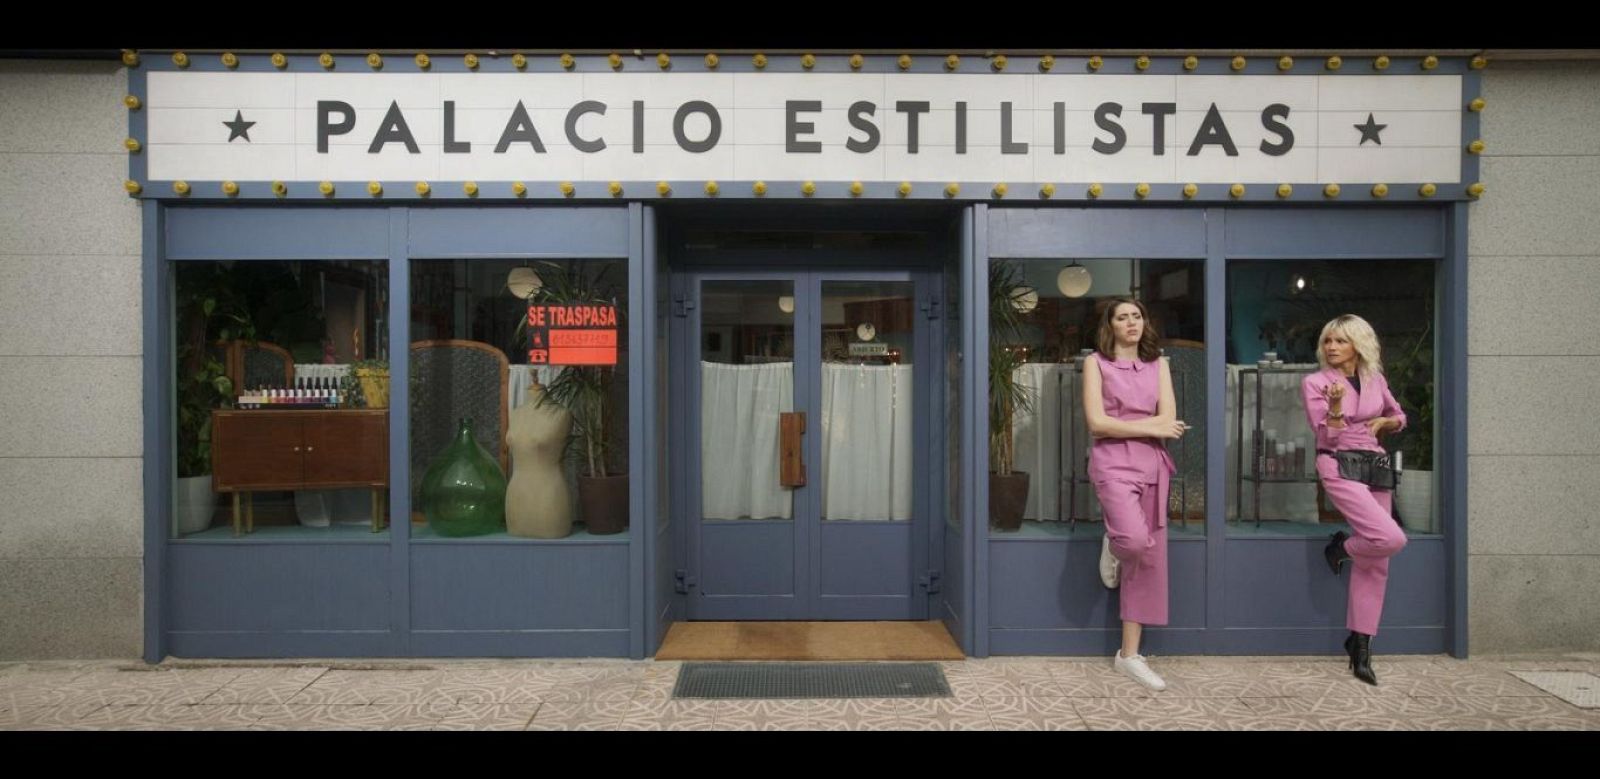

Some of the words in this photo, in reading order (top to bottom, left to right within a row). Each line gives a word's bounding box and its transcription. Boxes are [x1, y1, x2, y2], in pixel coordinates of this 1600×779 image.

[317, 99, 724, 155] PALACIO
[785, 99, 1296, 158] ESTILISTAS
[528, 306, 545, 326] SE
[548, 306, 616, 326] TRASPASA
